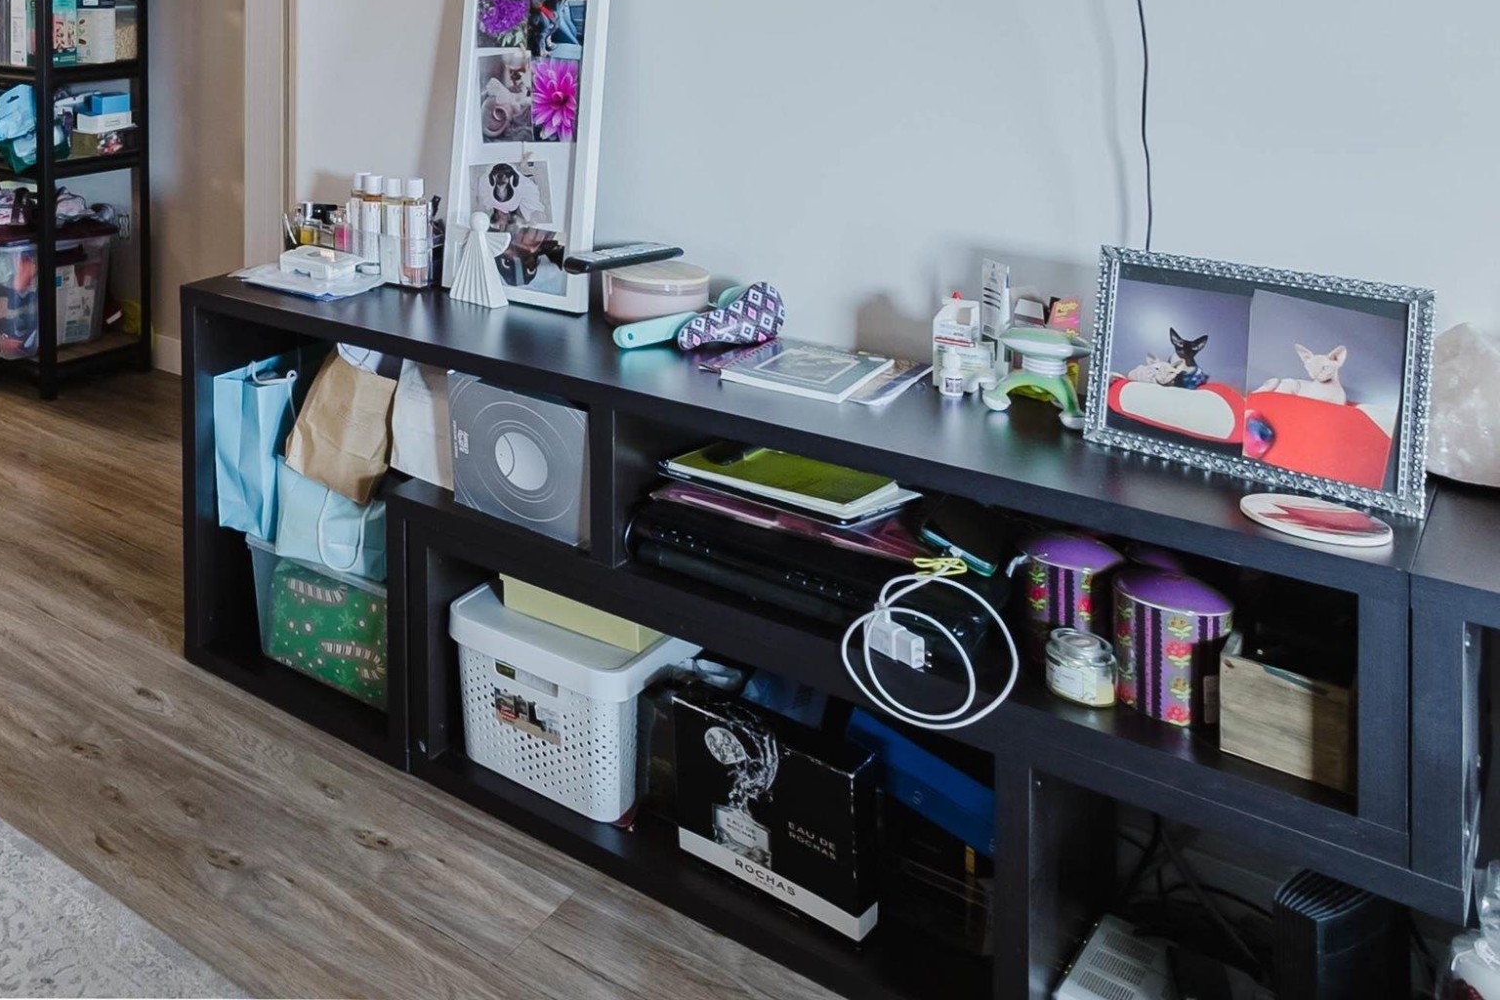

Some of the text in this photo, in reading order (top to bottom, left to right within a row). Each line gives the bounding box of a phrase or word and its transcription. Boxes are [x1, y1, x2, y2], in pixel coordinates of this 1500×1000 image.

[788, 820, 836, 852] EAU DE
[788, 830, 837, 861] ROCHAS
[734, 858, 796, 896] ROCHAS
